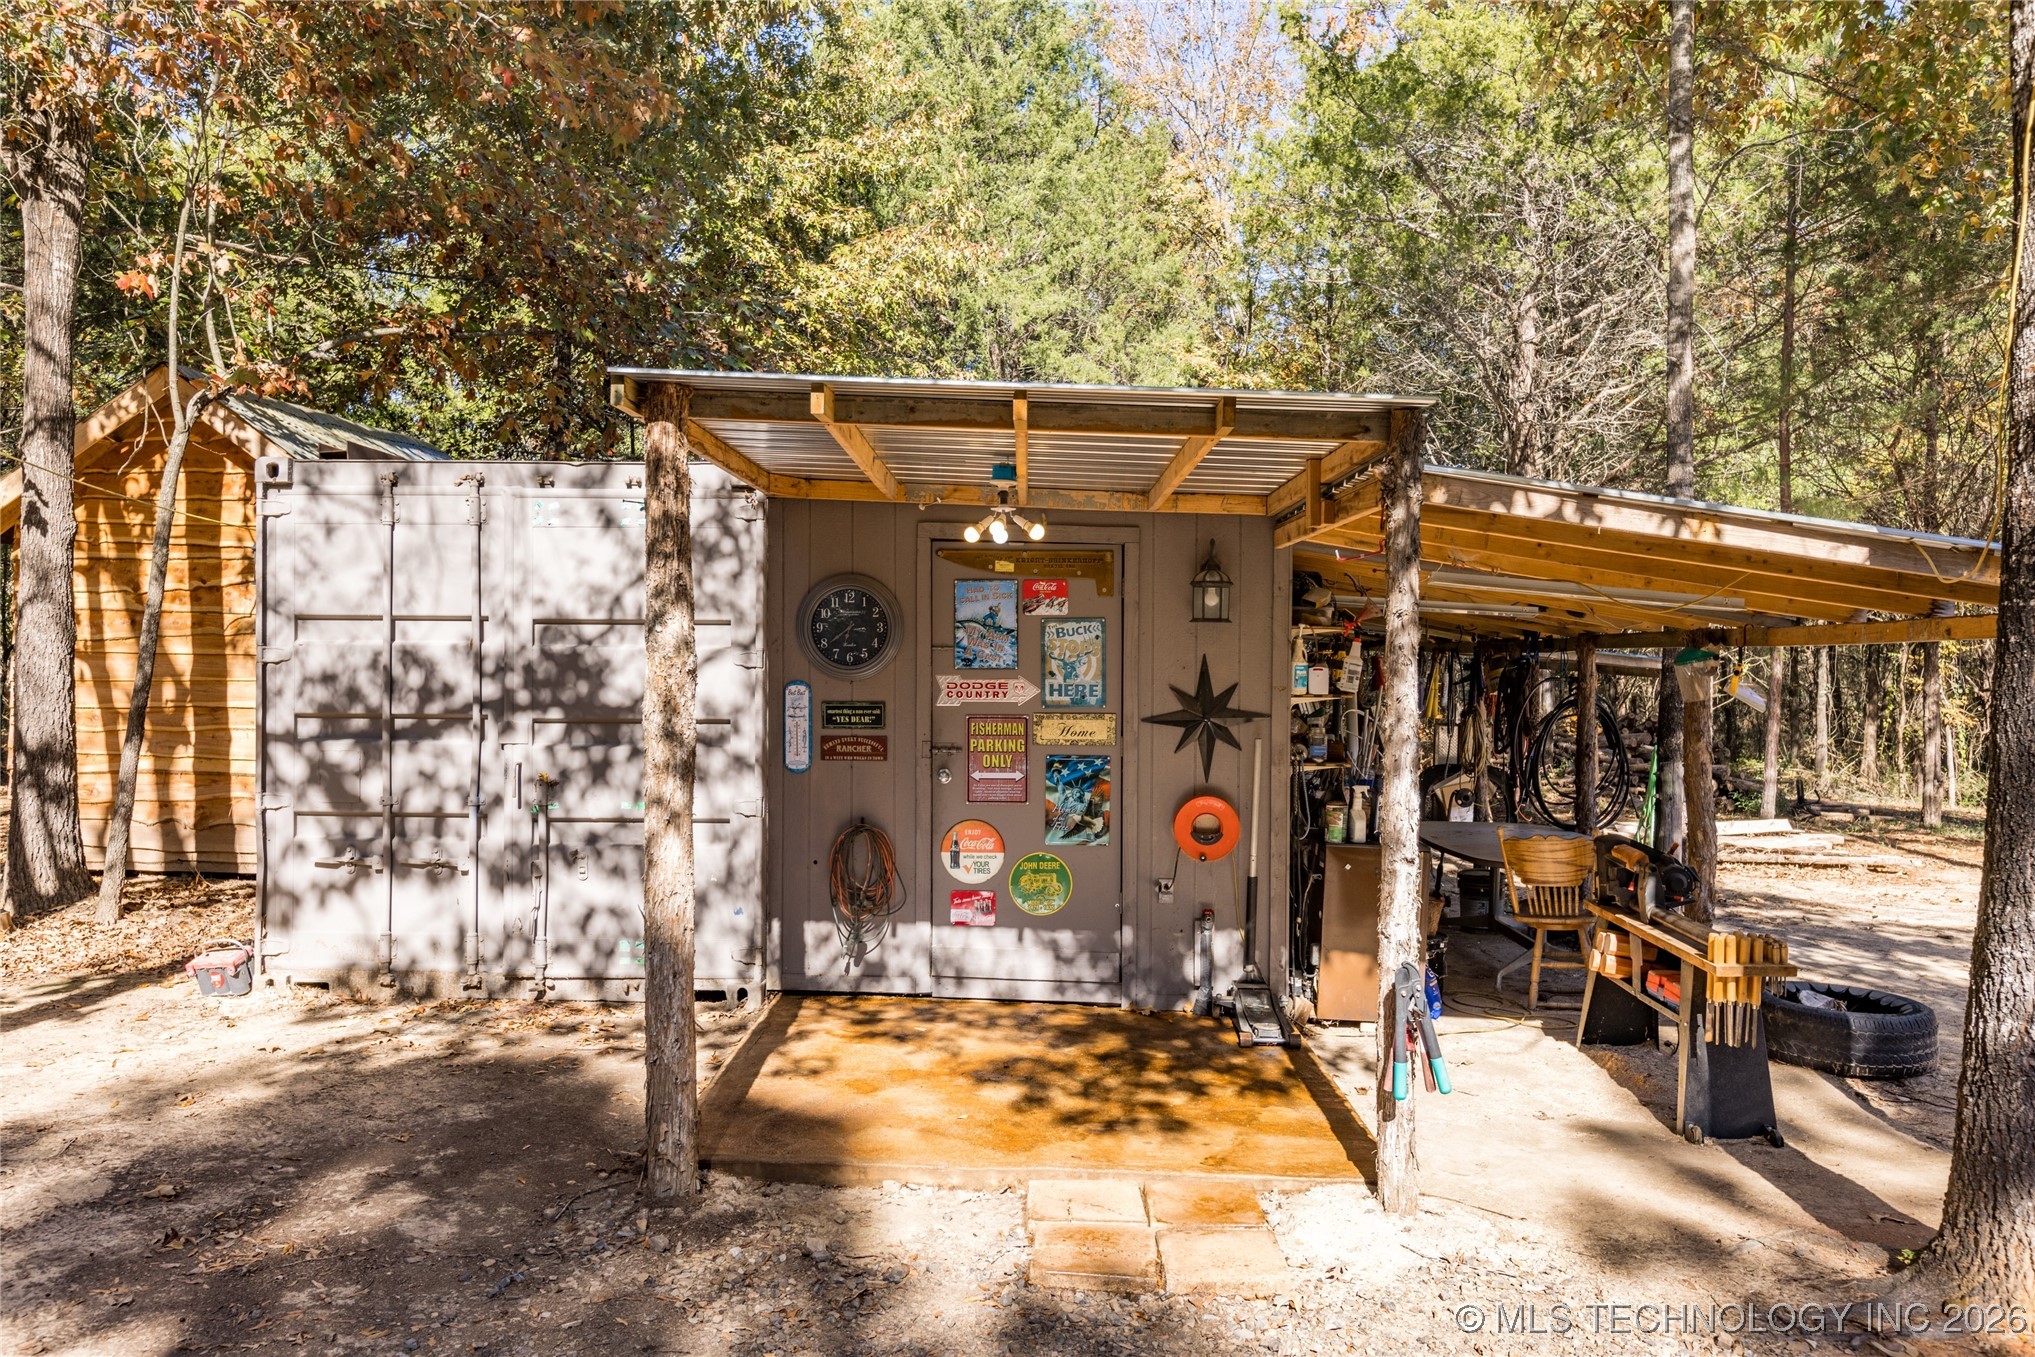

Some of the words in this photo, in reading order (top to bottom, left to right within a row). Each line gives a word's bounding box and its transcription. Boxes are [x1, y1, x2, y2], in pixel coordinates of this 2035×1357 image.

[966, 585, 984, 595] HAD
[989, 584, 1000, 593] TO
[831, 597, 839, 608] 11
[844, 591, 855, 603] 12
[862, 597, 866, 607] 1
[820, 608, 831, 619] 10
[872, 607, 879, 618] 2
[816, 622, 823, 633] 9
[876, 622, 884, 633] 3
[965, 624, 983, 638] MY
[1055, 624, 1093, 639] BUCK
[820, 638, 828, 648] 8
[871, 637, 878, 648] 4
[1048, 638, 1101, 658] STOPS
[832, 648, 840, 659] 7
[846, 652, 853, 663] 6
[861, 648, 868, 659] 5
[964, 648, 973, 657] A
[946, 682, 1009, 690] DODGE
[1049, 683, 1099, 698] HERE
[946, 690, 1009, 699] COUNTRY
[970, 722, 1025, 736] FISHERMAN
[1053, 722, 1096, 738] Home
[836, 745, 872, 753] RANCHER
[970, 739, 1025, 753] PARKING
[982, 754, 1013, 769] ONLY
[1052, 821, 1070, 831] Free
[959, 837, 997, 850] Coca-Cola
[973, 867, 991, 875] TIRES
[1019, 862, 1037, 870] JOHN
[1039, 861, 1061, 870] DEERE
